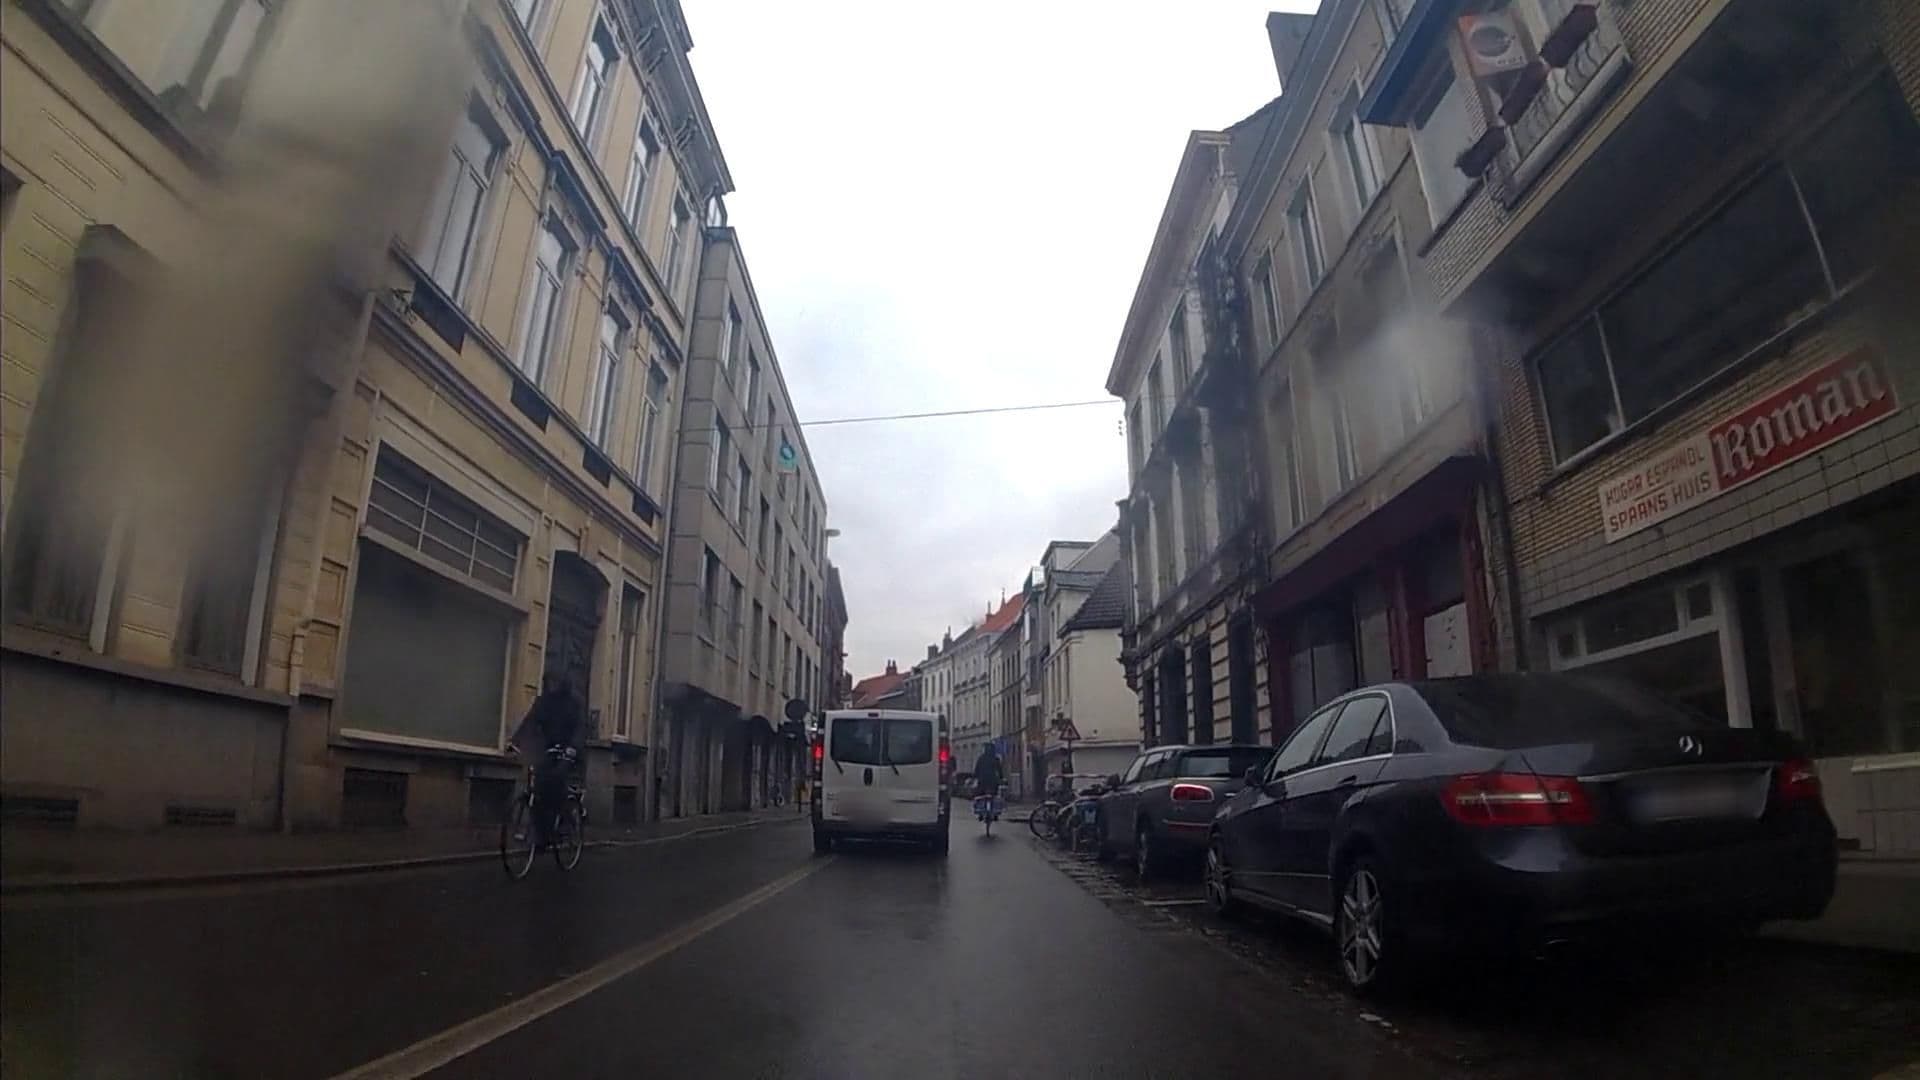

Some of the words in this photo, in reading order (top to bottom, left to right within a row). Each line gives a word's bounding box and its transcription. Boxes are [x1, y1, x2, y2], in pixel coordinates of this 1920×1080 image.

[1713, 359, 1887, 478] Roman
[1609, 492, 1669, 533] SPAANS
[1672, 471, 1712, 504] HUIS
